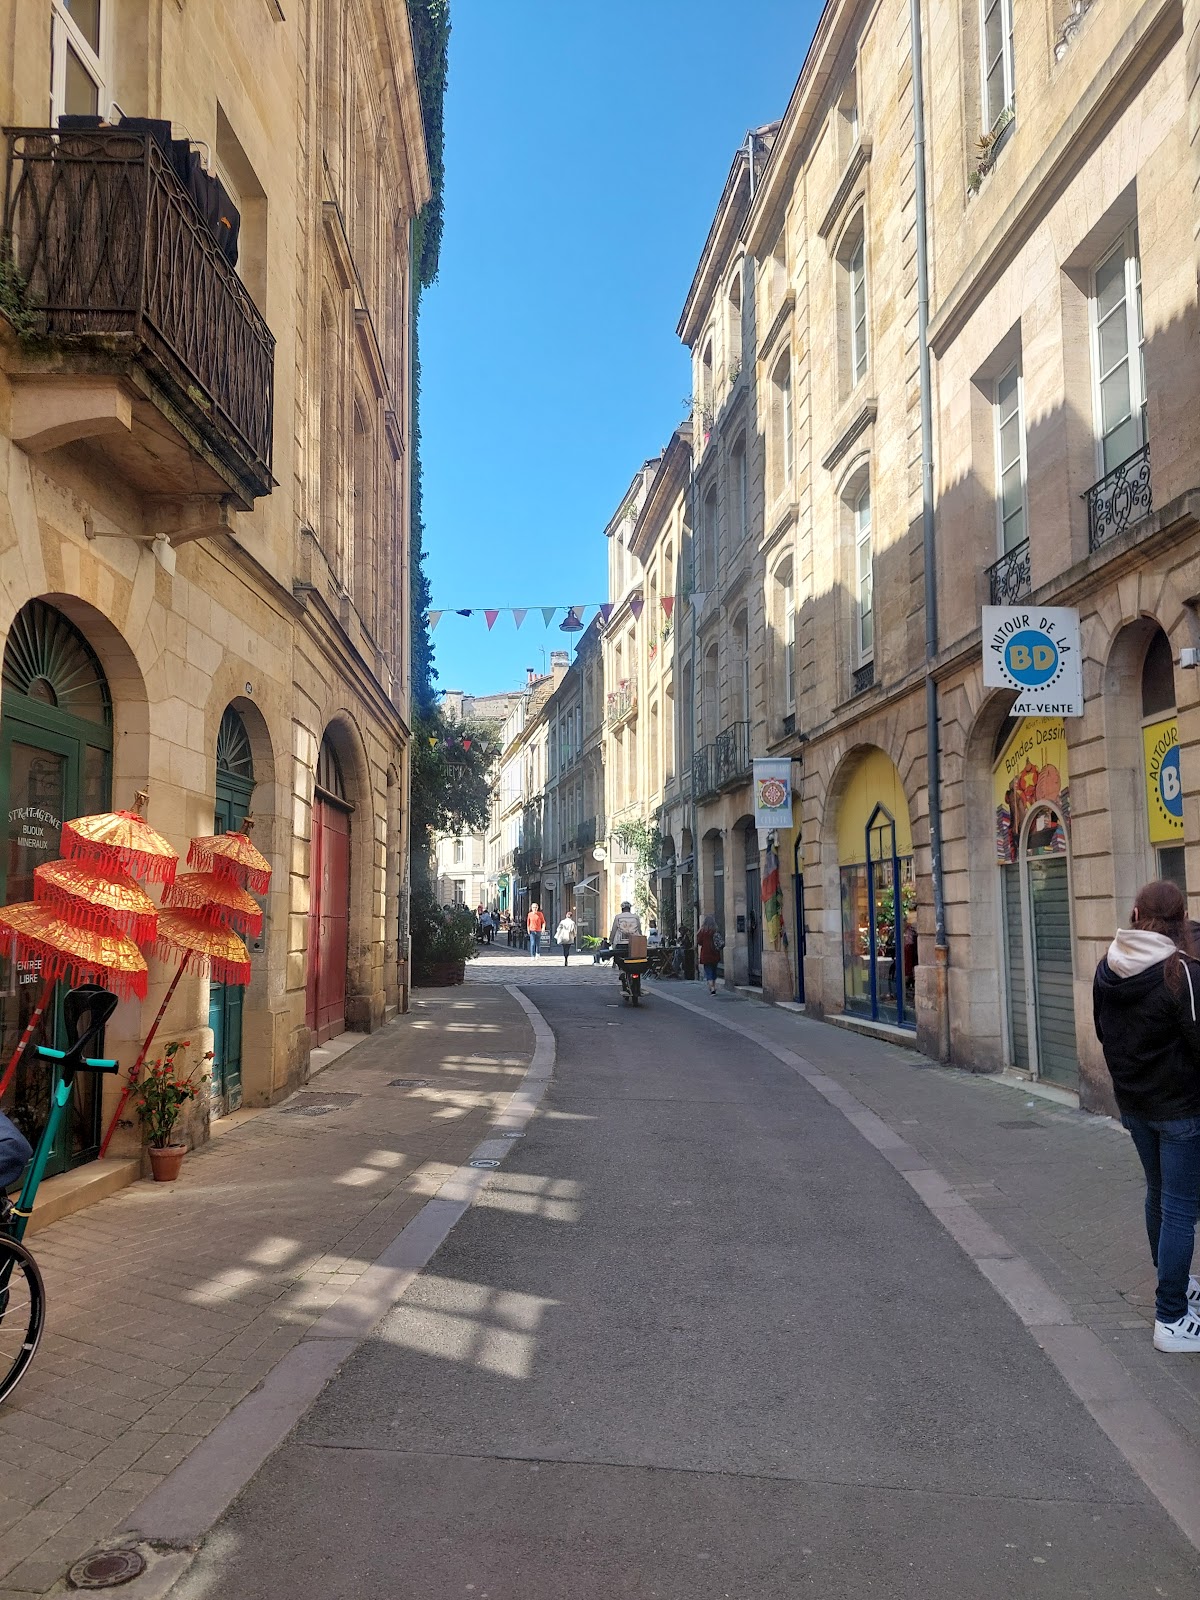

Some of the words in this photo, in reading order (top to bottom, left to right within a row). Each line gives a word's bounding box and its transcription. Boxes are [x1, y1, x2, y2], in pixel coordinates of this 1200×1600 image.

[991, 615, 1030, 653] AUTOUR
[1040, 618, 1056, 634] DE
[1056, 637, 1071, 654] LA
[1009, 645, 1056, 671] BD
[1006, 737, 1034, 774] Bandes
[1036, 723, 1065, 745] Dessin
[1149, 727, 1178, 781] AUTOUR
[8, 807, 61, 830] STRATAGEME
[22, 825, 44, 836] BIJOUX
[17, 836, 48, 849] MINERAUX
[17, 960, 42, 971] ENTREE
[19, 973, 38, 985] LIBRE
